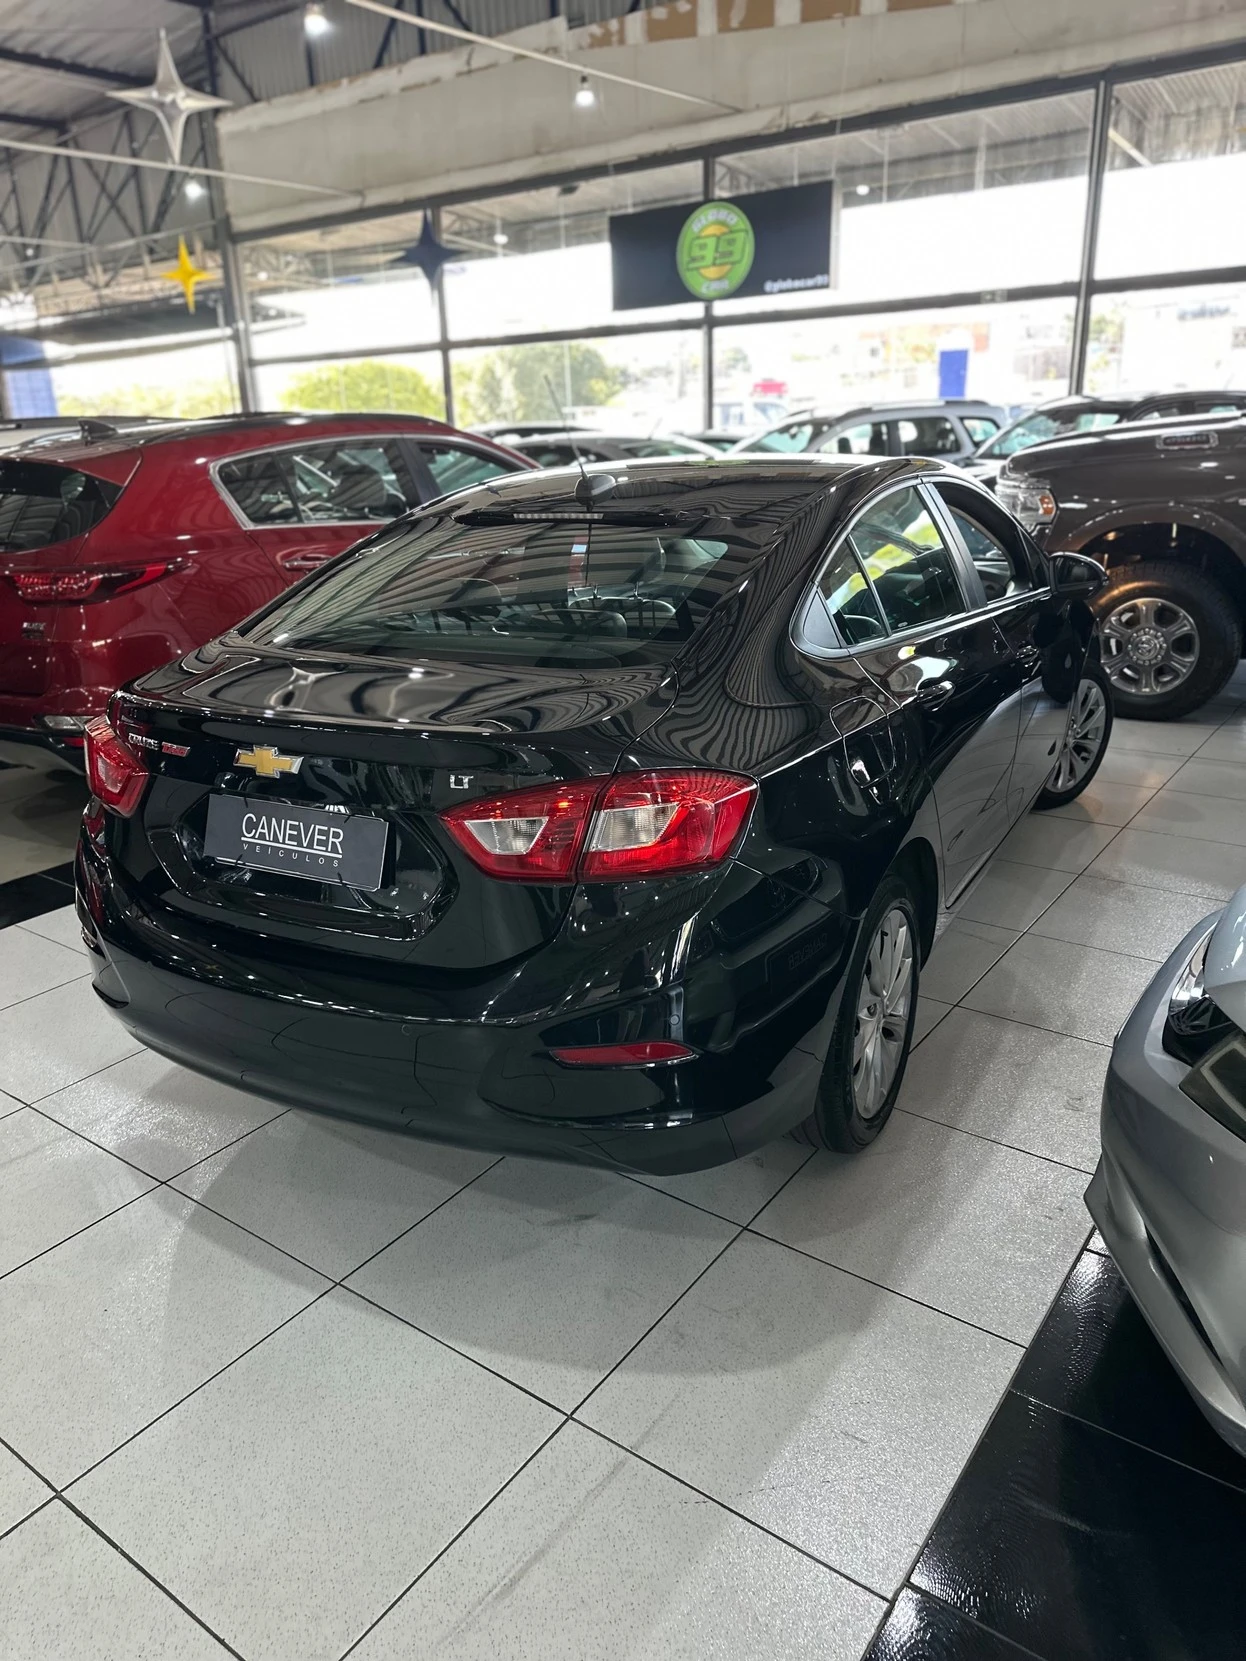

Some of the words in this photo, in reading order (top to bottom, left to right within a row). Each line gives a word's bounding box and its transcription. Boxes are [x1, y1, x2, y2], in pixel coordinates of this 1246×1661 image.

[128, 732, 160, 751] CRUZE
[449, 774, 474, 789] LT
[242, 812, 344, 854] CANEVER
[242, 843, 339, 868] VEICULOS
